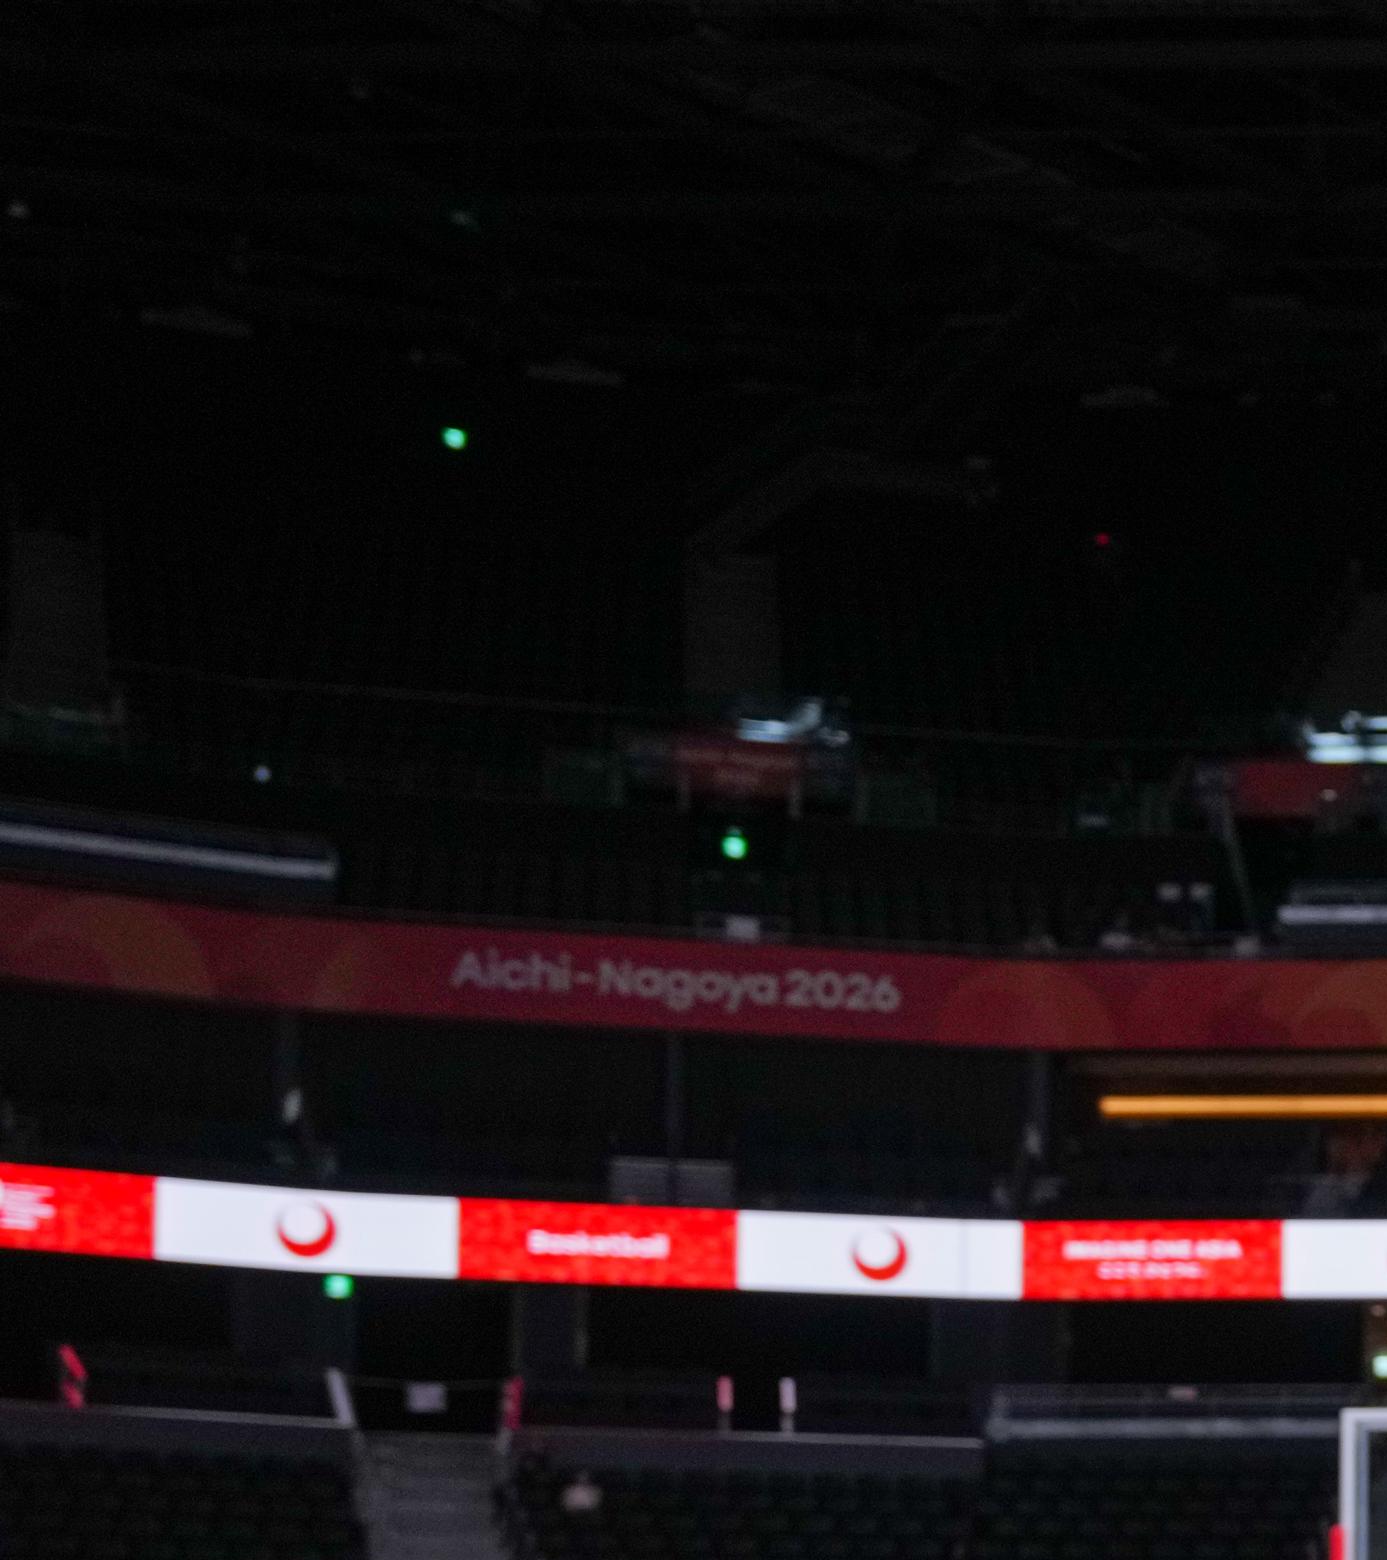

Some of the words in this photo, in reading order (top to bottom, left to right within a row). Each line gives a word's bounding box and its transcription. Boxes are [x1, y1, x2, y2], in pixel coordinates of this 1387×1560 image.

[451, 946, 779, 1013] Aichi-Nagoya
[785, 968, 901, 1013] 2026
[527, 1229, 670, 1259] Basketball
